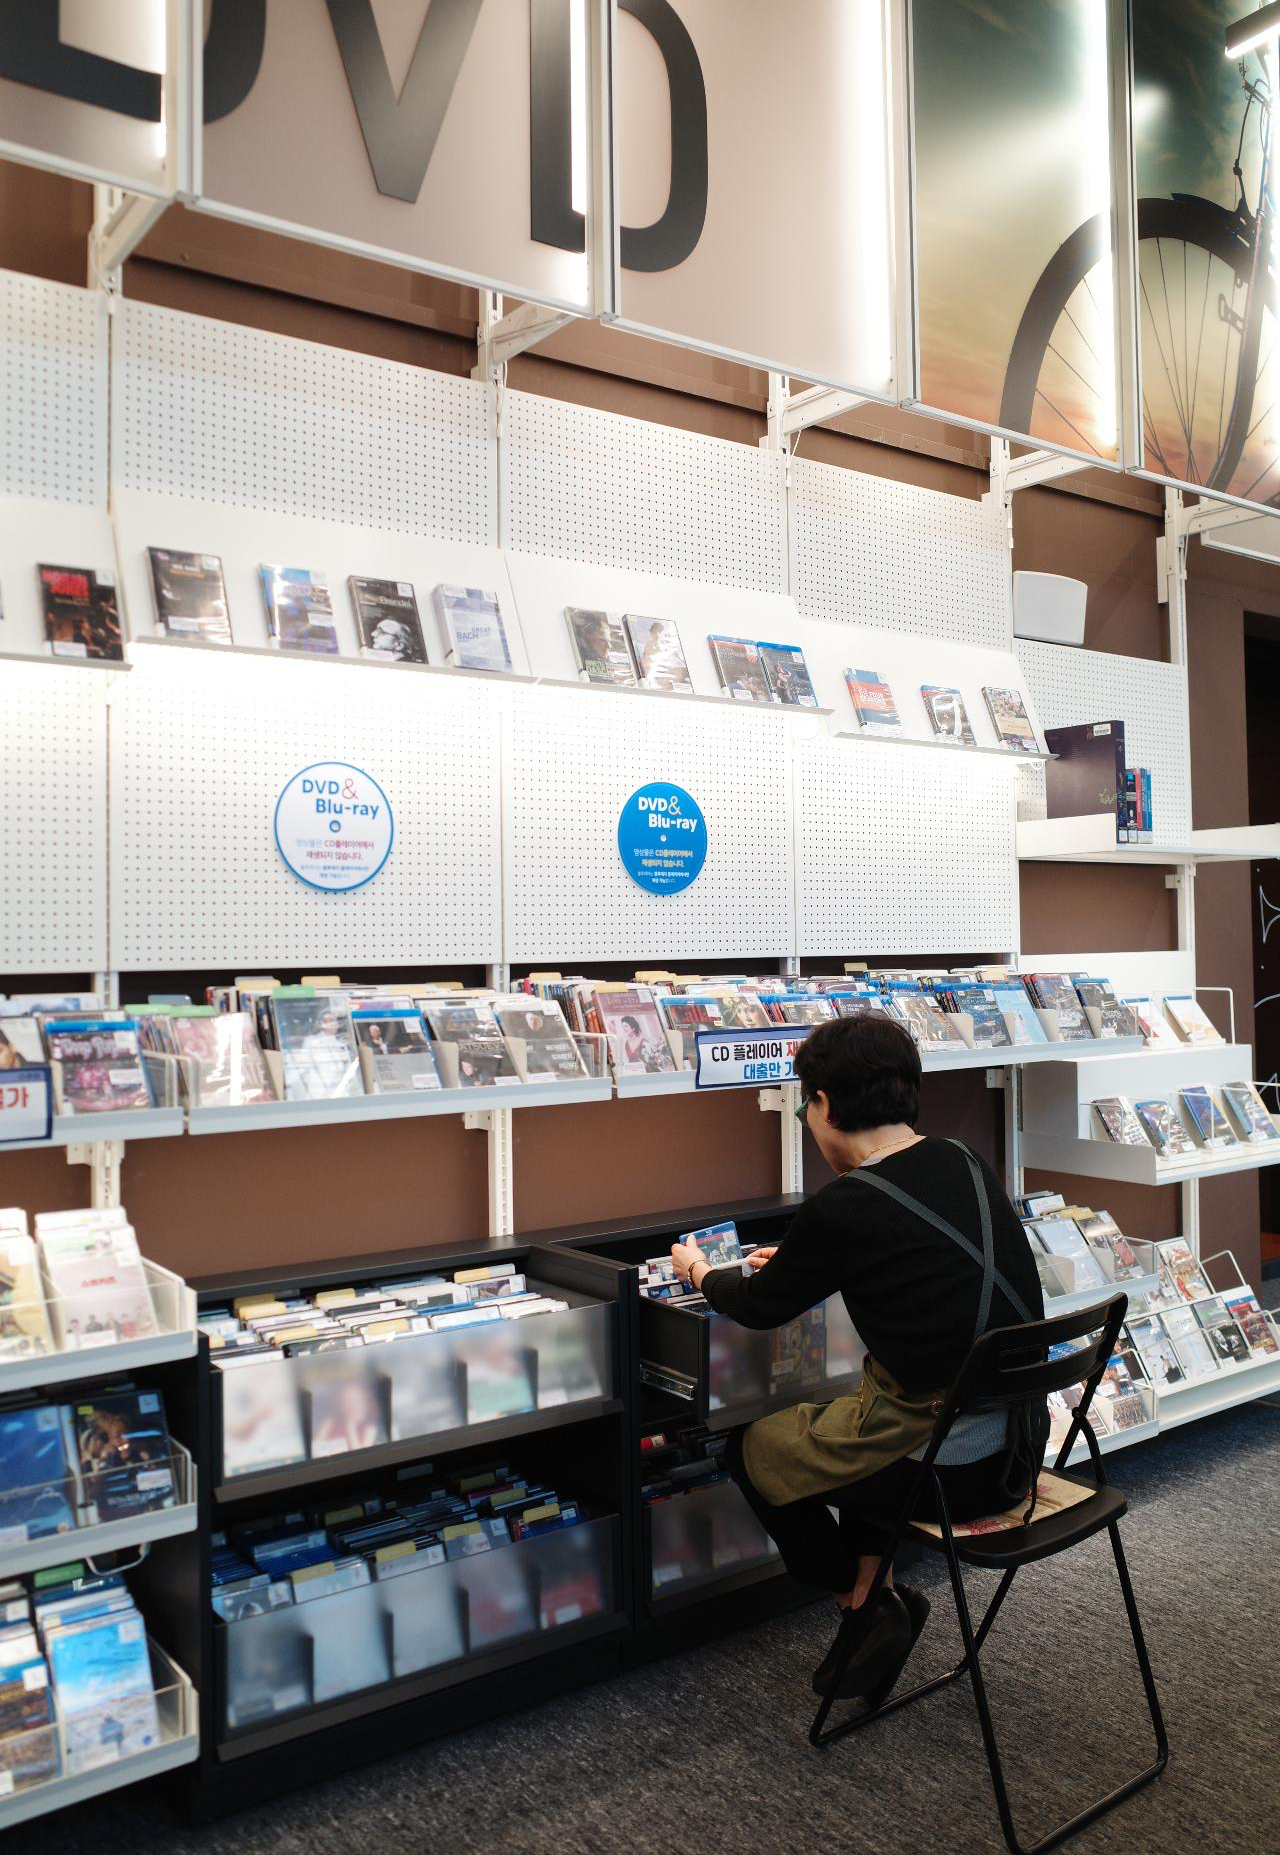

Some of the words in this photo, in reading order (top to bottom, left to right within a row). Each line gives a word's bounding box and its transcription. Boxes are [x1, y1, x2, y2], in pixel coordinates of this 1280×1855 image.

[315, 798, 379, 820] Blu-ray
[648, 813, 697, 832] Blu-ray
[711, 1046, 729, 1062] CD
[734, 1042, 782, 1061] 플레이어
[786, 1041, 800, 1056] 재
[743, 1062, 780, 1080] 대출만
[0, 1086, 29, 1109] 가
